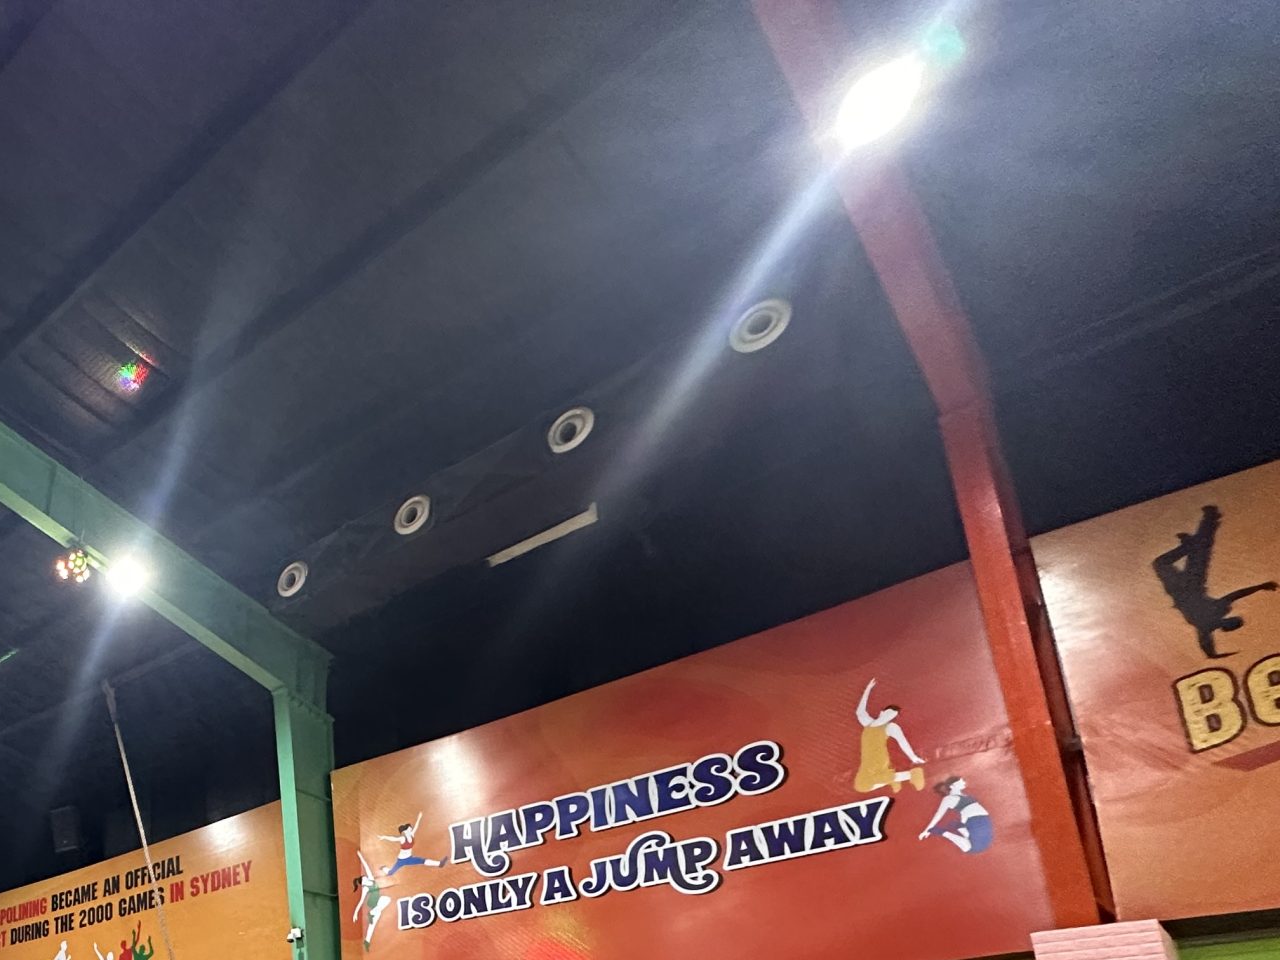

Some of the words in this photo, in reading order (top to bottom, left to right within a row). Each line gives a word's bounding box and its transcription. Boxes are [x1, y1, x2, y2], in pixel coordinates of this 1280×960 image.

[397, 892, 435, 930] IS
[435, 872, 538, 922] ONLY
[540, 866, 578, 905] A
[579, 831, 720, 894] JUMP
[723, 796, 890, 870] AWAY
[449, 741, 785, 877] HAPPINESS
[10, 920, 50, 945] DURING
[54, 913, 74, 935] THE
[79, 902, 113, 928] 2000
[118, 887, 165, 917] GAMES
[170, 880, 184, 903] IN
[190, 860, 252, 897] SYDNEY
[51, 882, 98, 912] BECAME
[103, 875, 120, 897] AN
[125, 856, 183, 890] OFFICIAL
